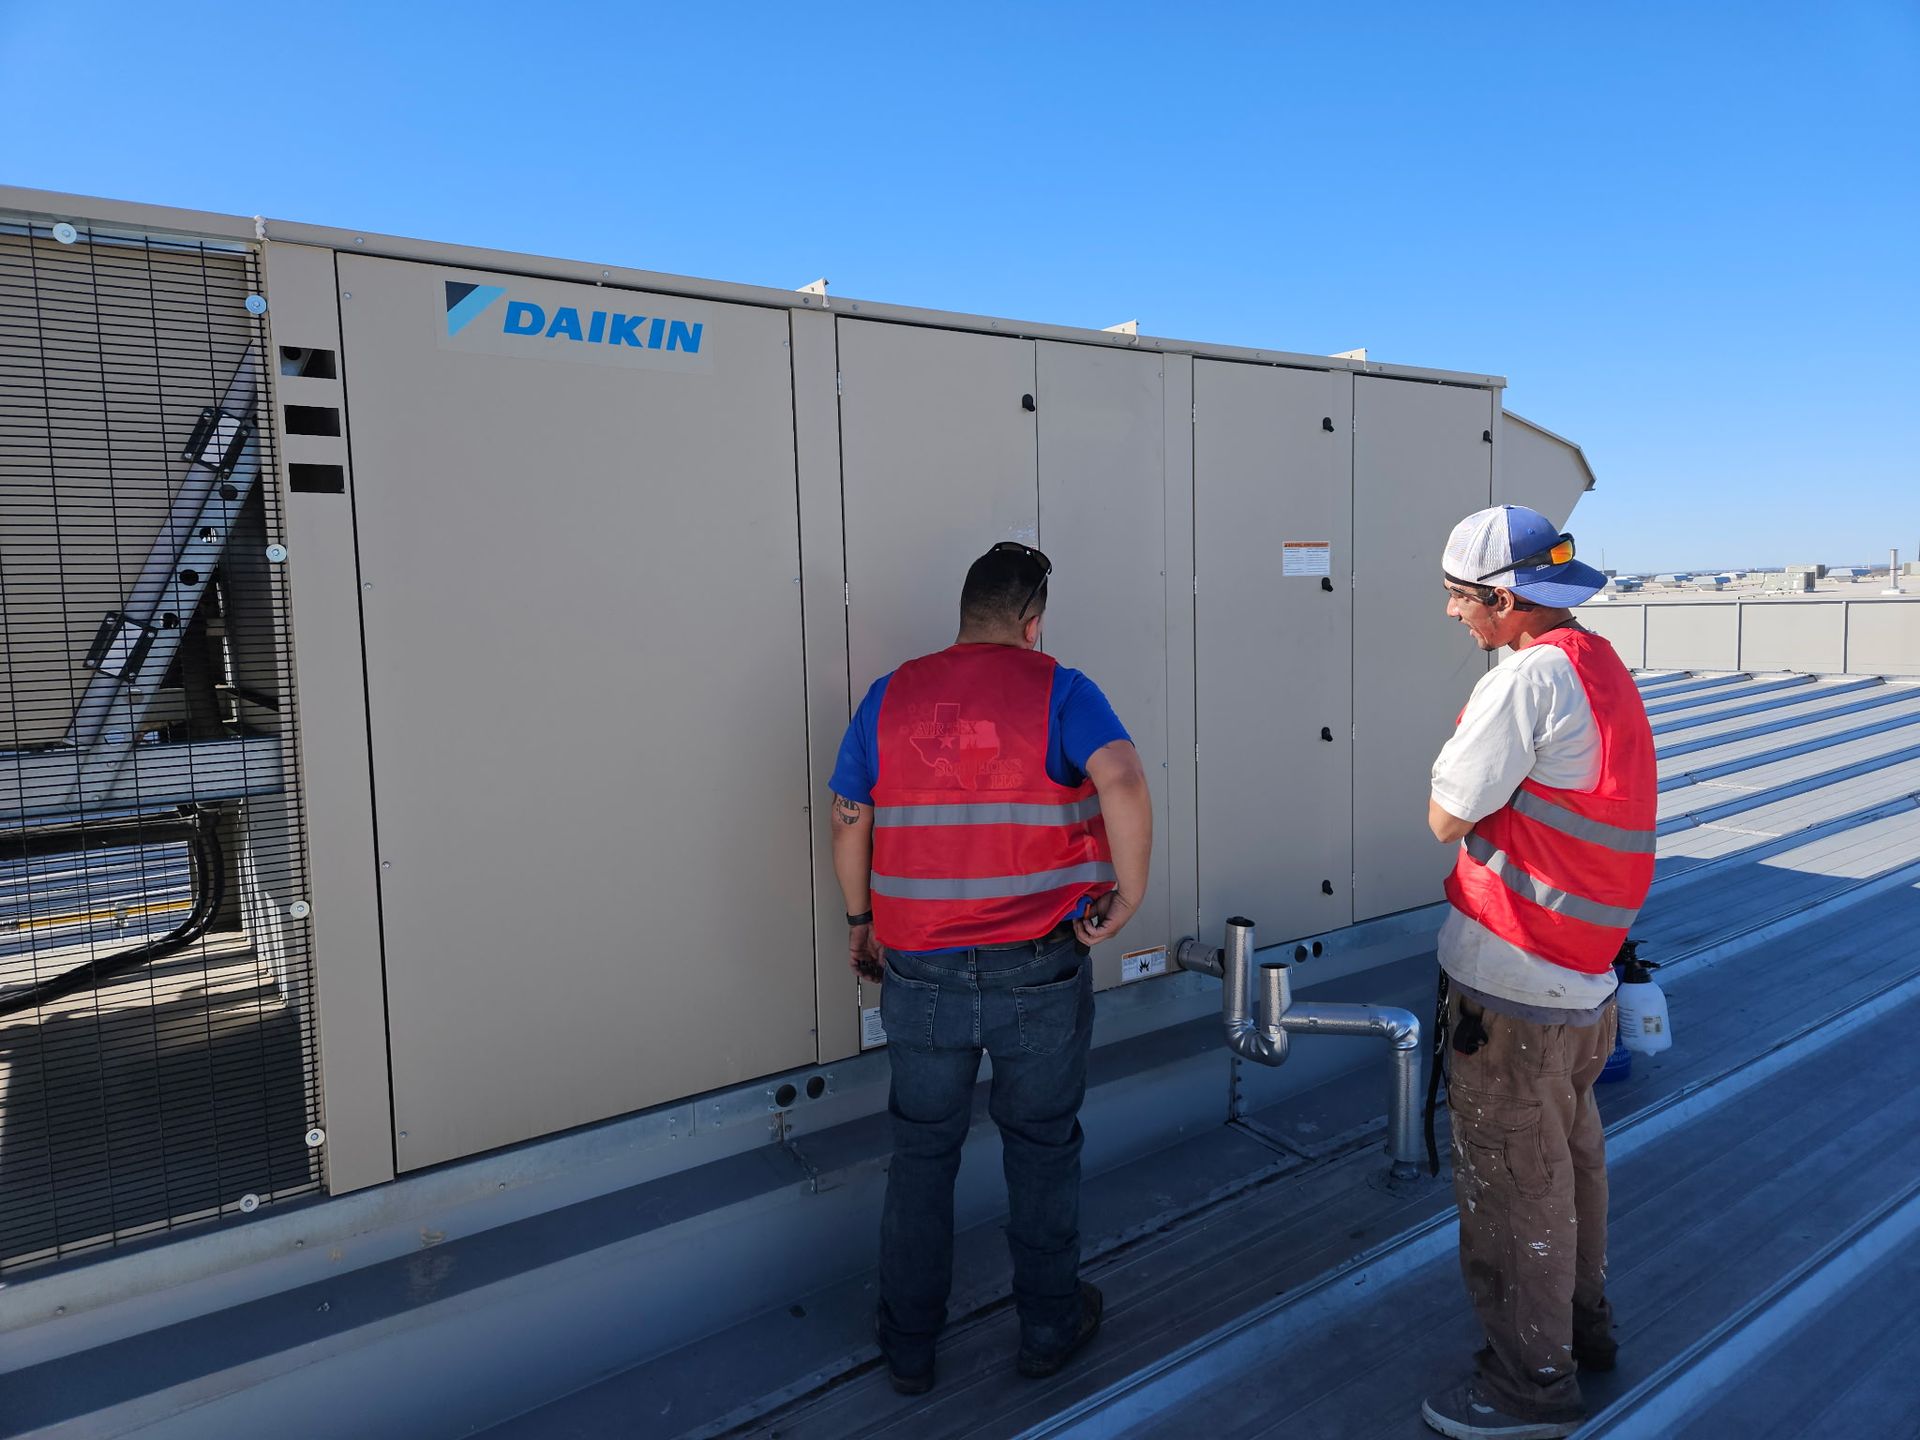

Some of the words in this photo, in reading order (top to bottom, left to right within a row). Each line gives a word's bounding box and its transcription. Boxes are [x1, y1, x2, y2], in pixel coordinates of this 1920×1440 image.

[503, 300, 704, 354] DAIKIN
[914, 720, 945, 737] AIR
[934, 759, 1024, 777] SOIONS
